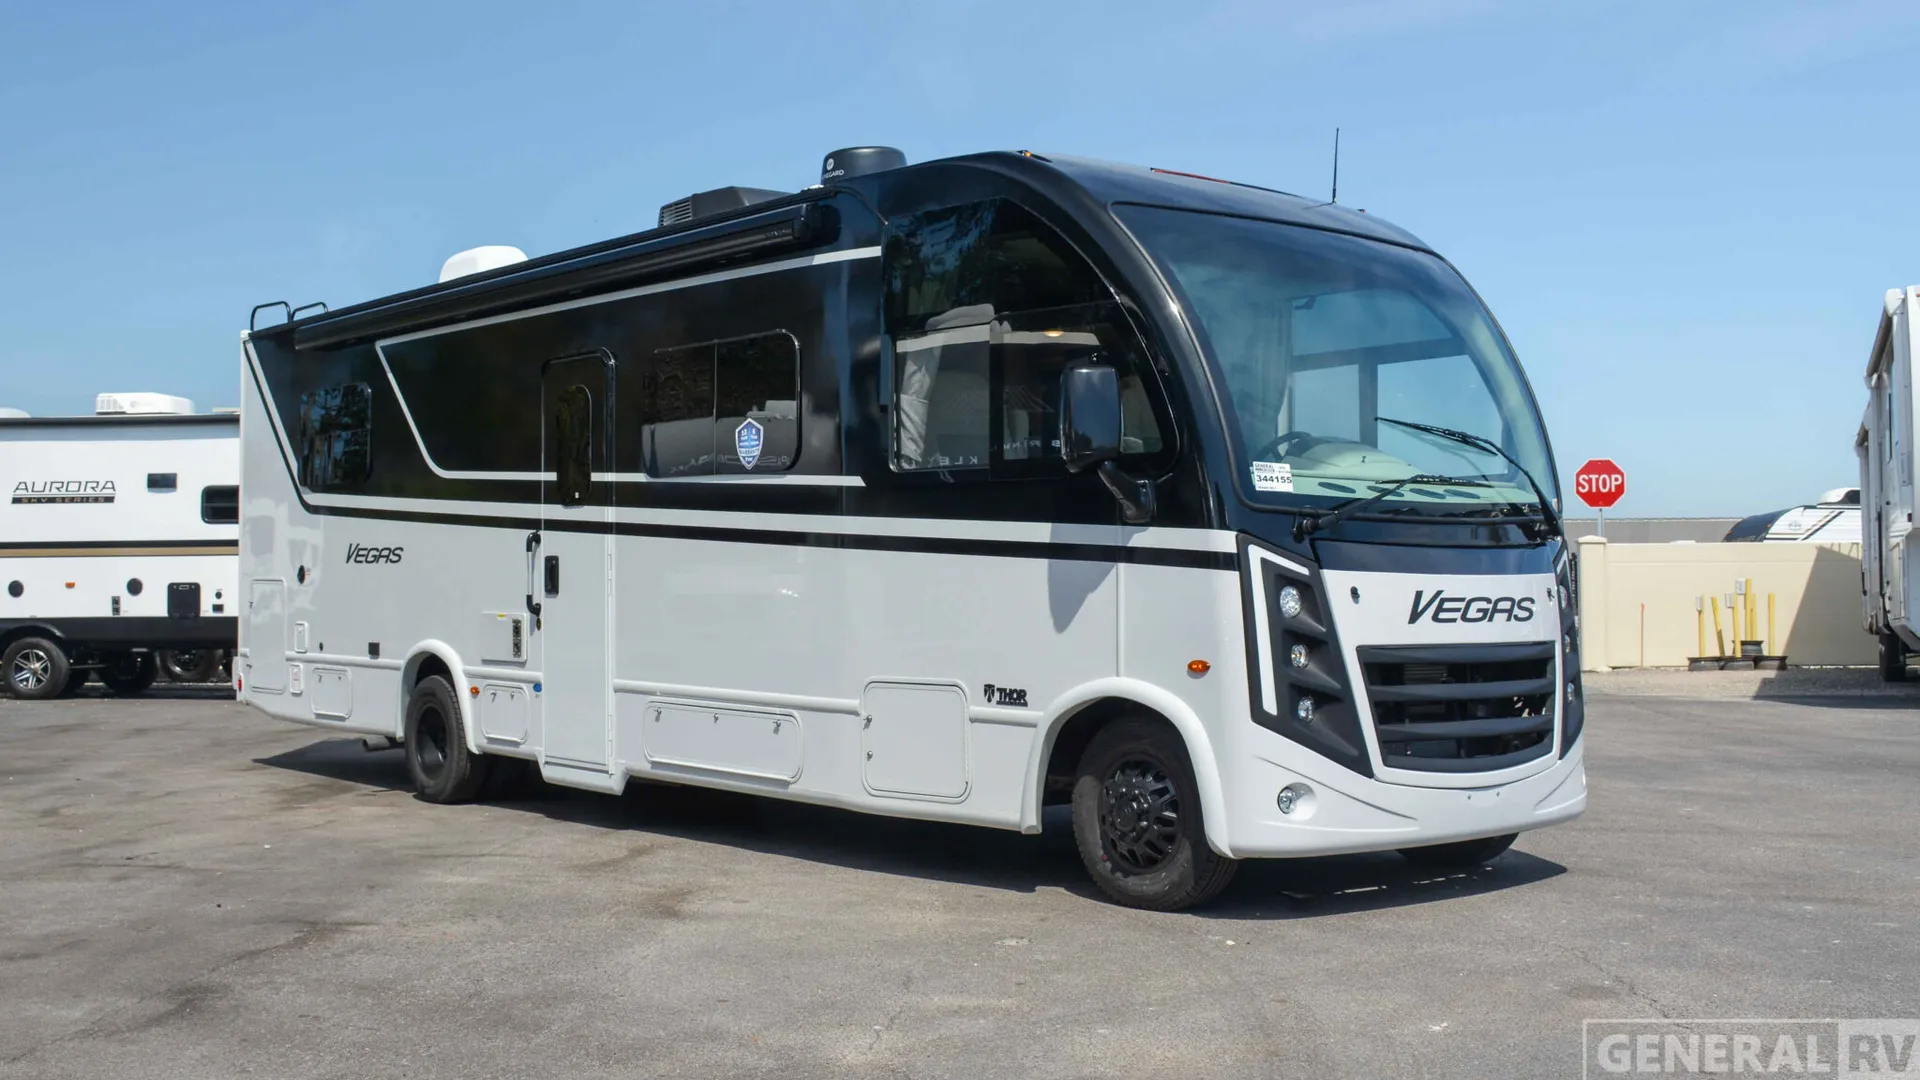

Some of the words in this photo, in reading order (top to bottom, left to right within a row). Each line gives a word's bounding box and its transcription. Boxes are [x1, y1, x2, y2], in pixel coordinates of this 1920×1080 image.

[13, 480, 116, 493] AURORA
[1256, 475, 1293, 484] 344155
[1578, 474, 1622, 493] STOP
[345, 543, 404, 564] VEGAS
[1408, 590, 1535, 624] VEGAS
[996, 687, 1028, 706] THOR
